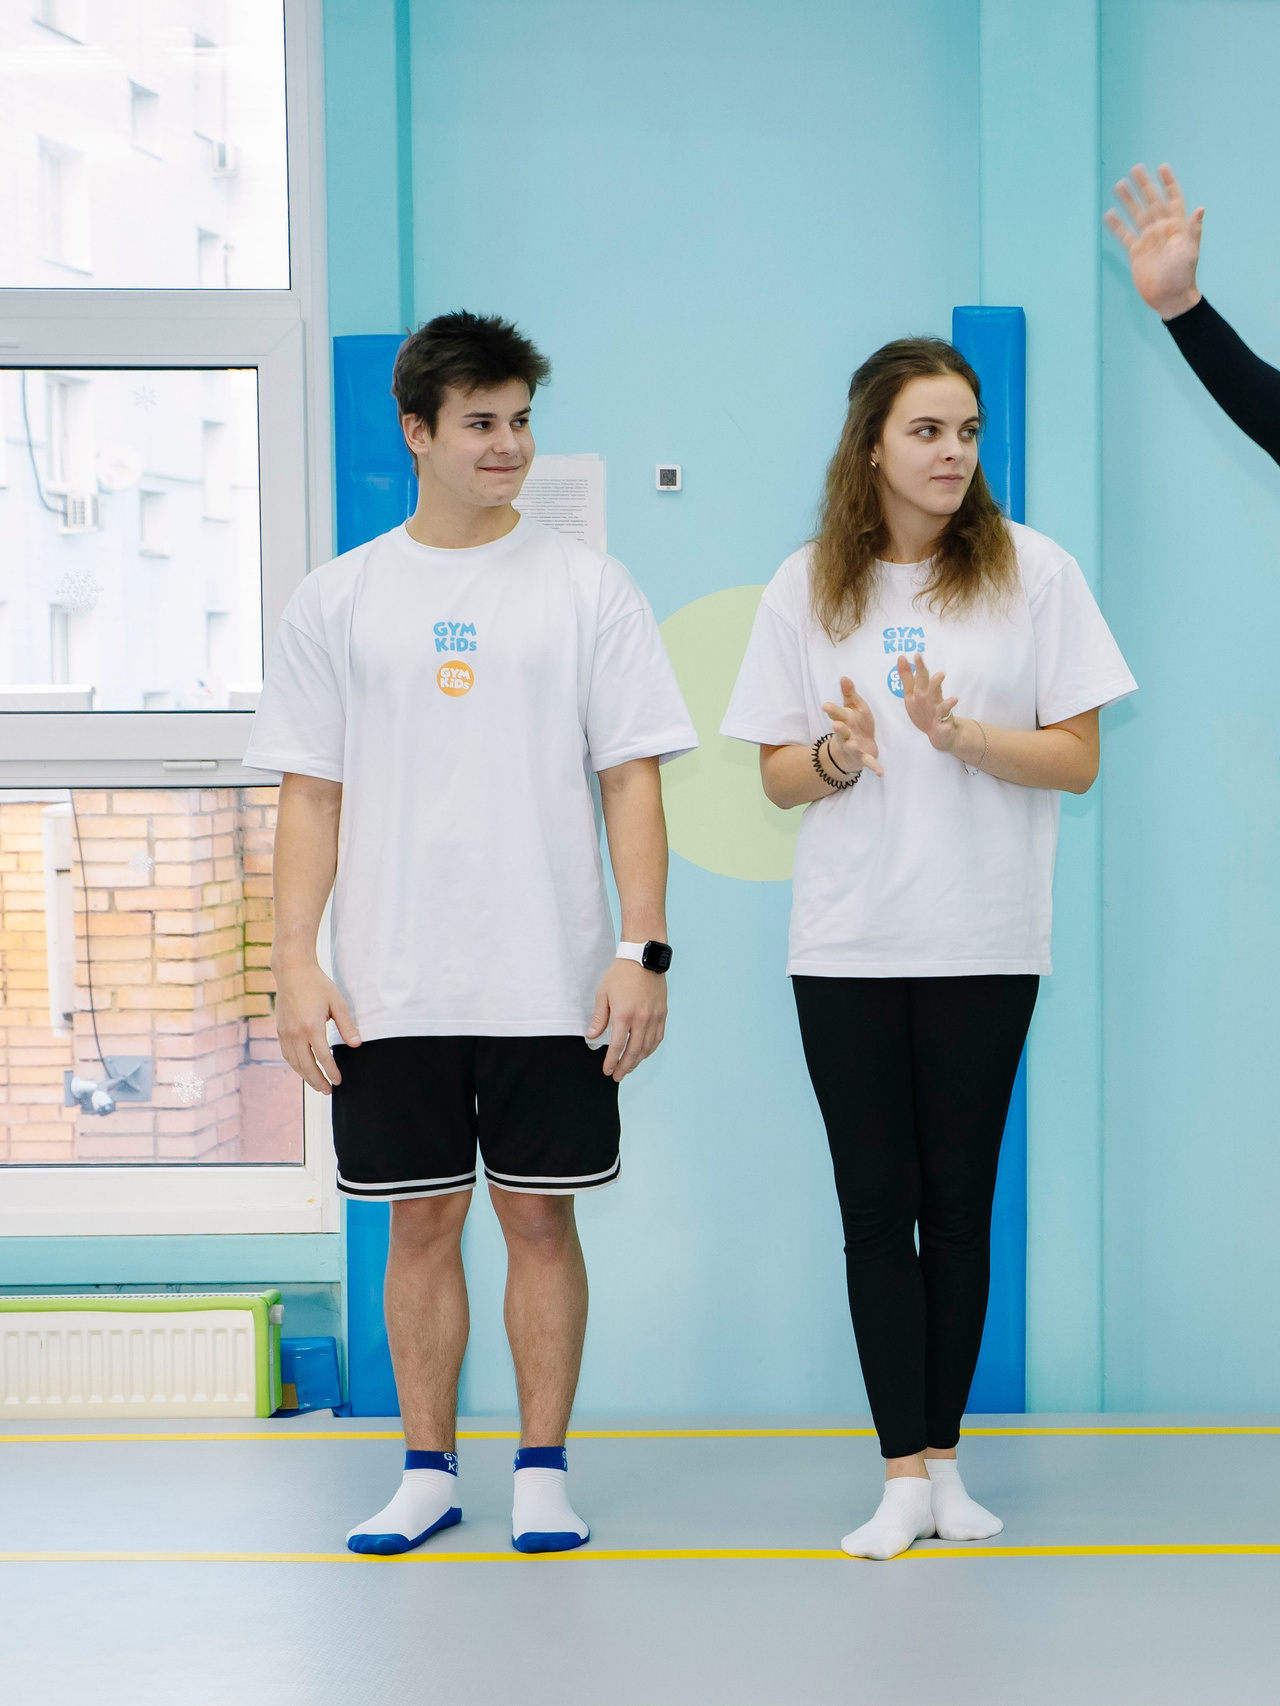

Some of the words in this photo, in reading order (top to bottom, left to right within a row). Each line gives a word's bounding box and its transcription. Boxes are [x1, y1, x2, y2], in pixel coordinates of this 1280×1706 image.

[433, 621, 477, 637] GYM
[882, 626, 925, 639] GYM
[440, 667, 471, 680] GYM
